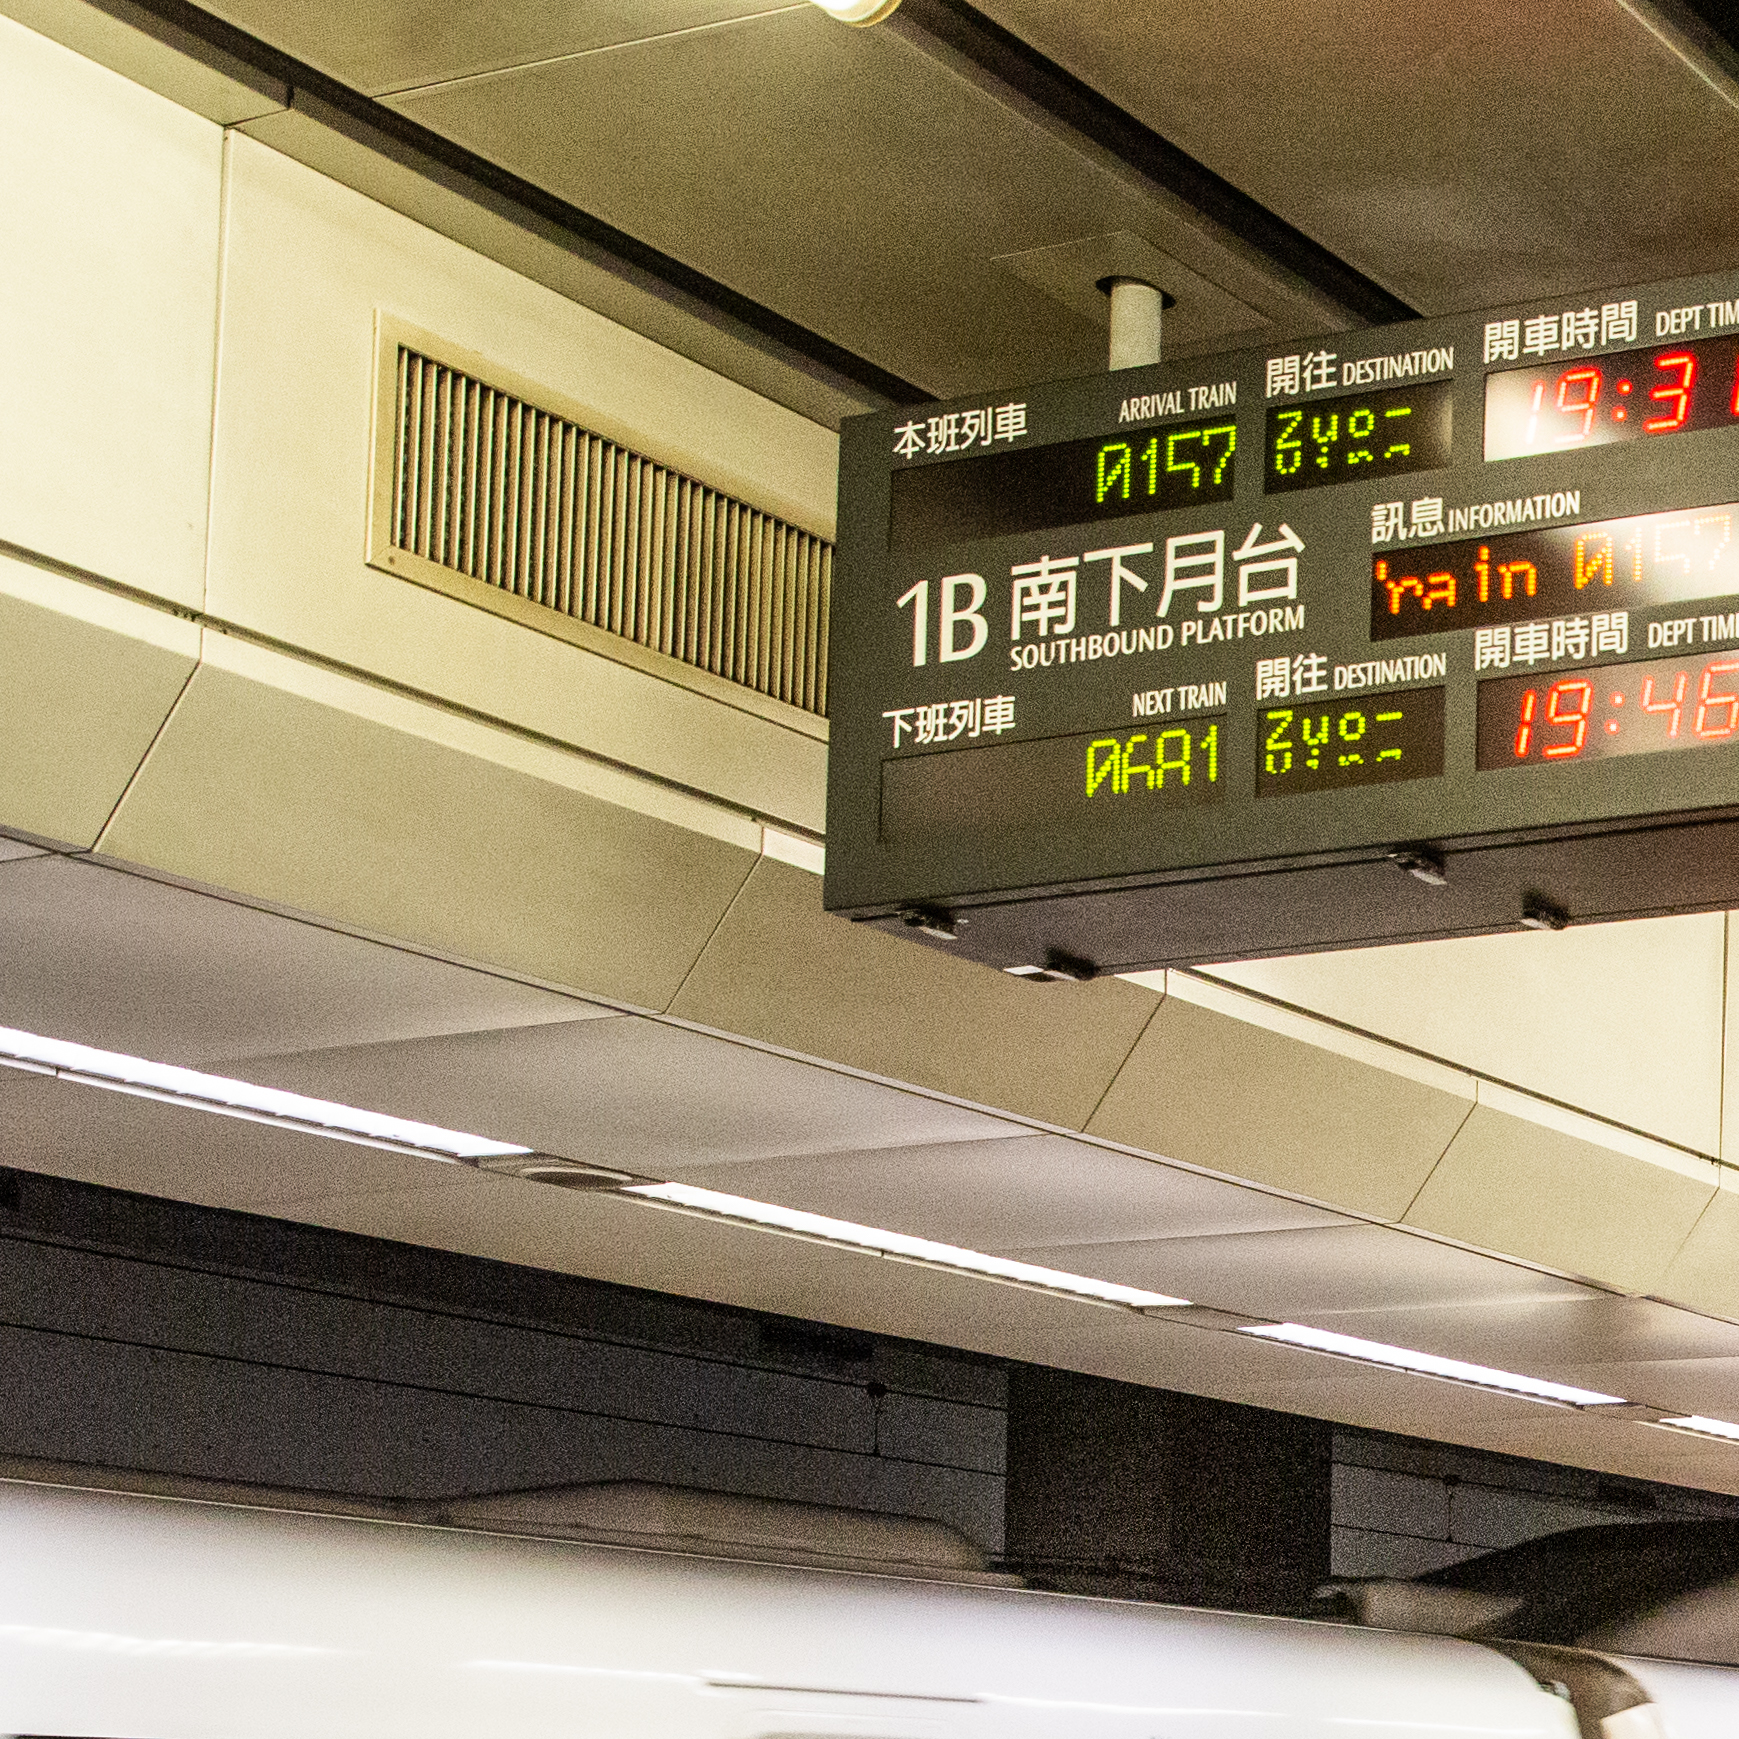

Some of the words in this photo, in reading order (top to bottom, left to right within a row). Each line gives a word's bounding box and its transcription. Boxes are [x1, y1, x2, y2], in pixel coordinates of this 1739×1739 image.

[1484, 301, 1638, 364] 開車時間
[1656, 305, 1702, 337] DEPT
[1266, 352, 1336, 397] 開往
[1342, 347, 1454, 387] DESTINATION
[1119, 392, 1184, 423] ARRIVAL
[1188, 382, 1237, 413] TRAIN
[893, 403, 1027, 459] 本班列車
[1371, 498, 1444, 543] 訊息
[1448, 491, 1580, 533] INFORMATION
[896, 575, 989, 666] 1B
[1010, 522, 1306, 641] 南下月台
[1010, 626, 1173, 671] SOUTHBOUND
[1181, 605, 1304, 646] PLATFORM
[1474, 612, 1628, 671] 開車時間
[1648, 618, 1695, 649] DEPT
[1133, 688, 1174, 717] NEXT
[1177, 682, 1226, 712] TRAIN
[1256, 653, 1326, 699] 開往
[1334, 653, 1446, 690] DESTINATION
[882, 697, 1016, 748] 下班列車
